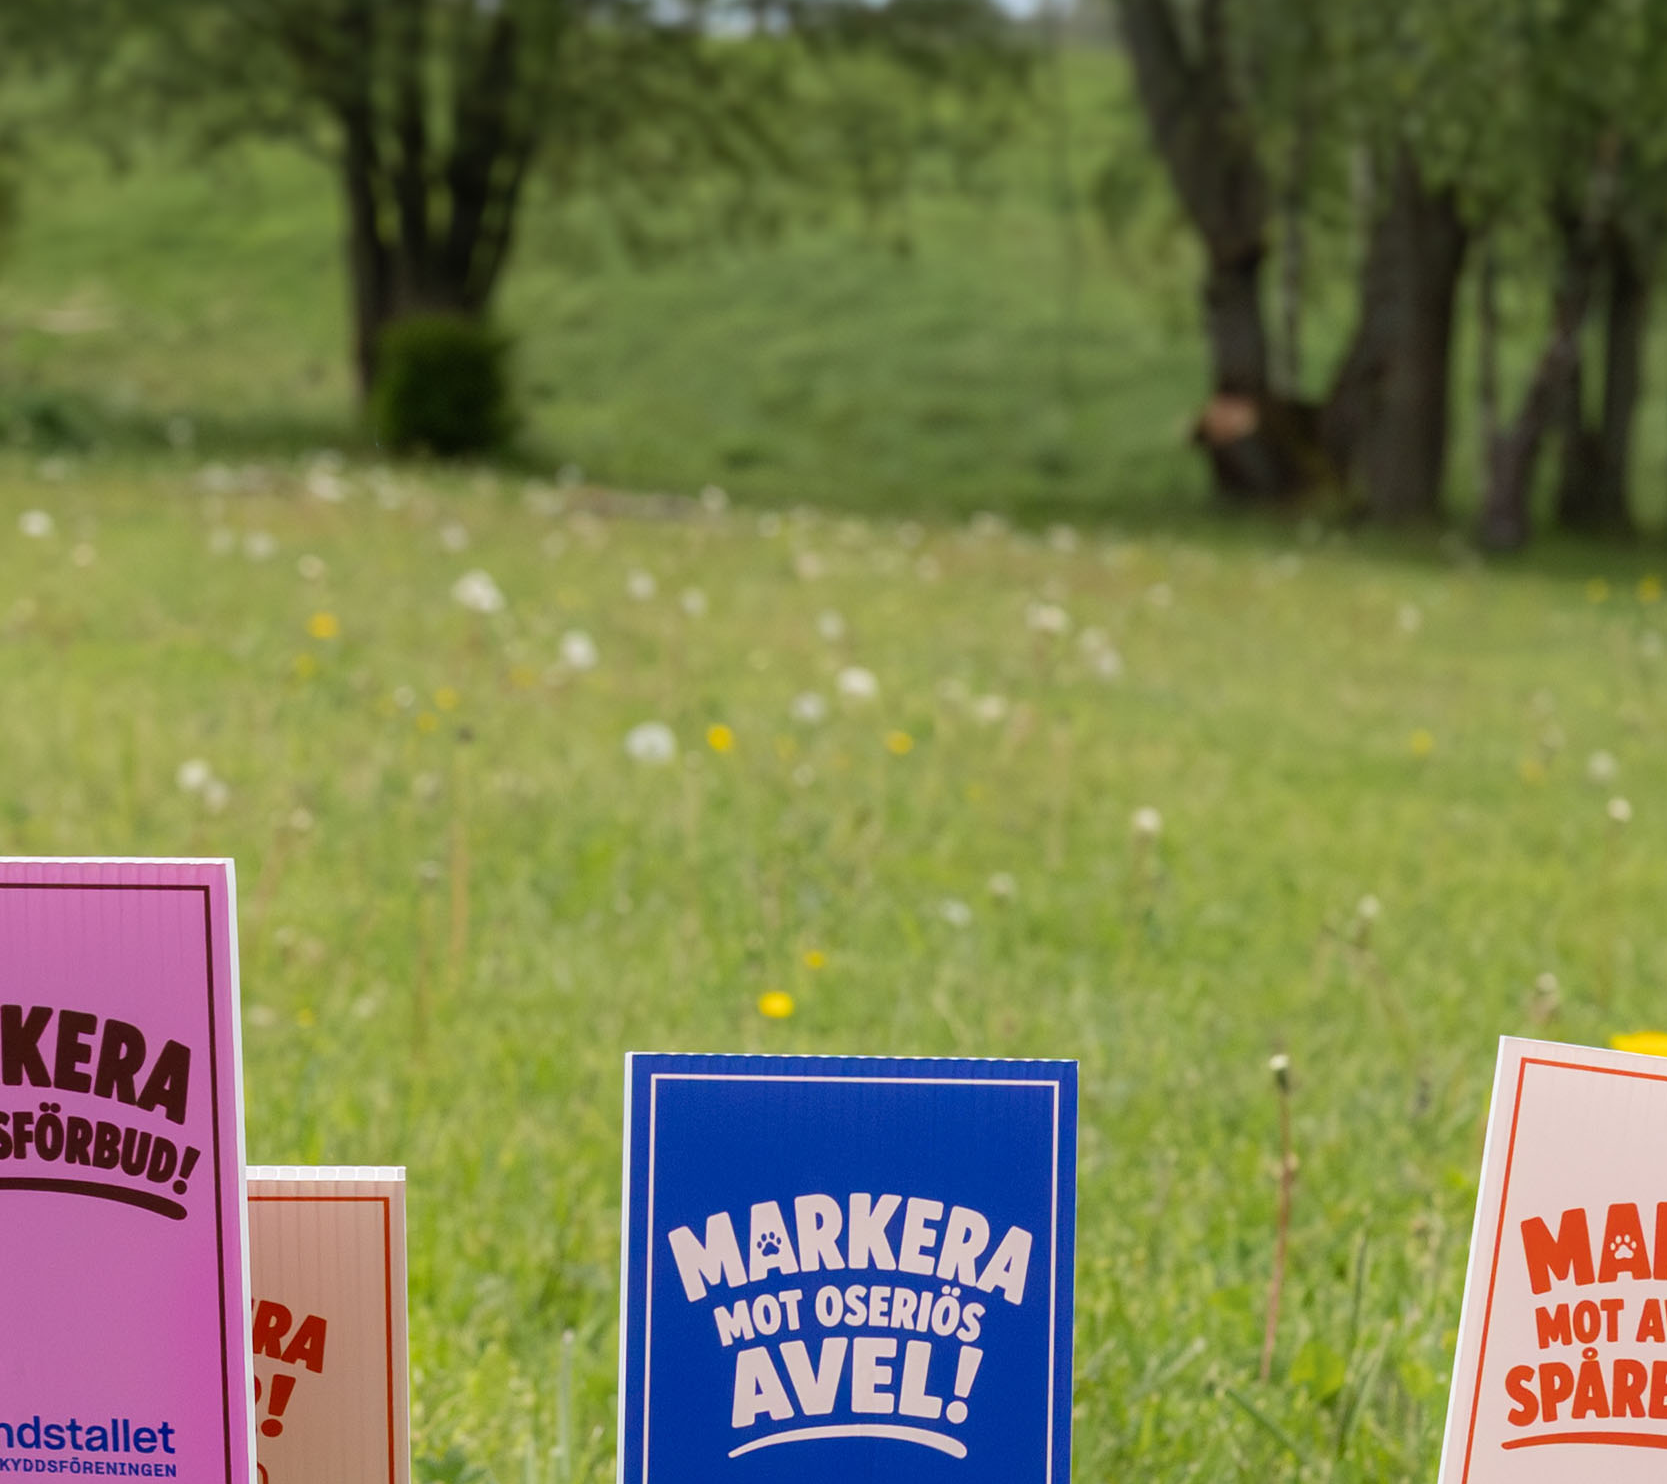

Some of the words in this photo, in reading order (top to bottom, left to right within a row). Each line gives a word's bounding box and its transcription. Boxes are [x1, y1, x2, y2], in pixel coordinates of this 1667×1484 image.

[668, 1193, 1032, 1305] MARKERA
[714, 1289, 802, 1346] MOT
[815, 1284, 985, 1342] OSERIÖS
[1535, 1299, 1624, 1351] MOT
[732, 1337, 983, 1428] AVEL!
